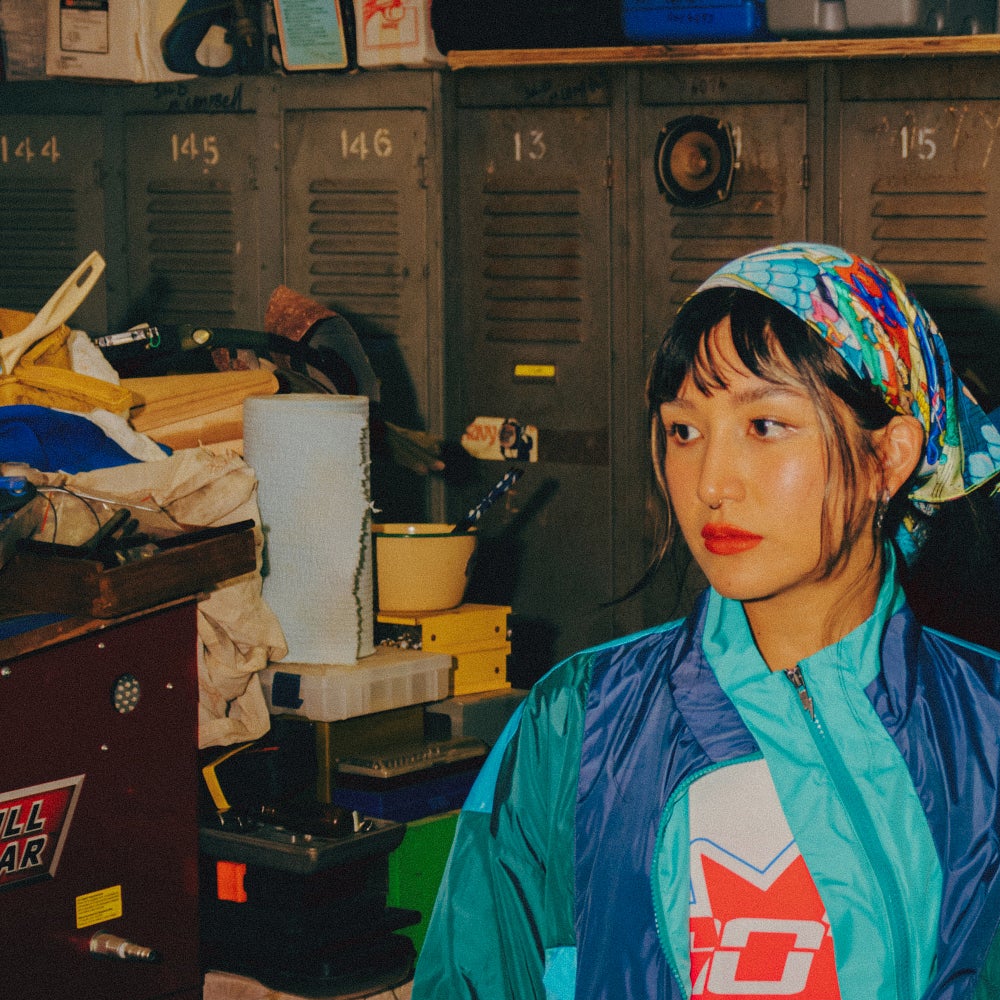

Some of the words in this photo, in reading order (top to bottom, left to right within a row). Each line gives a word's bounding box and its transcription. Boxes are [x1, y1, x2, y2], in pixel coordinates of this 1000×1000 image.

[1, 134, 62, 164] 144
[171, 132, 219, 165] 145
[341, 127, 393, 160] 146
[514, 129, 546, 162] 13
[900, 126, 937, 160] 15
